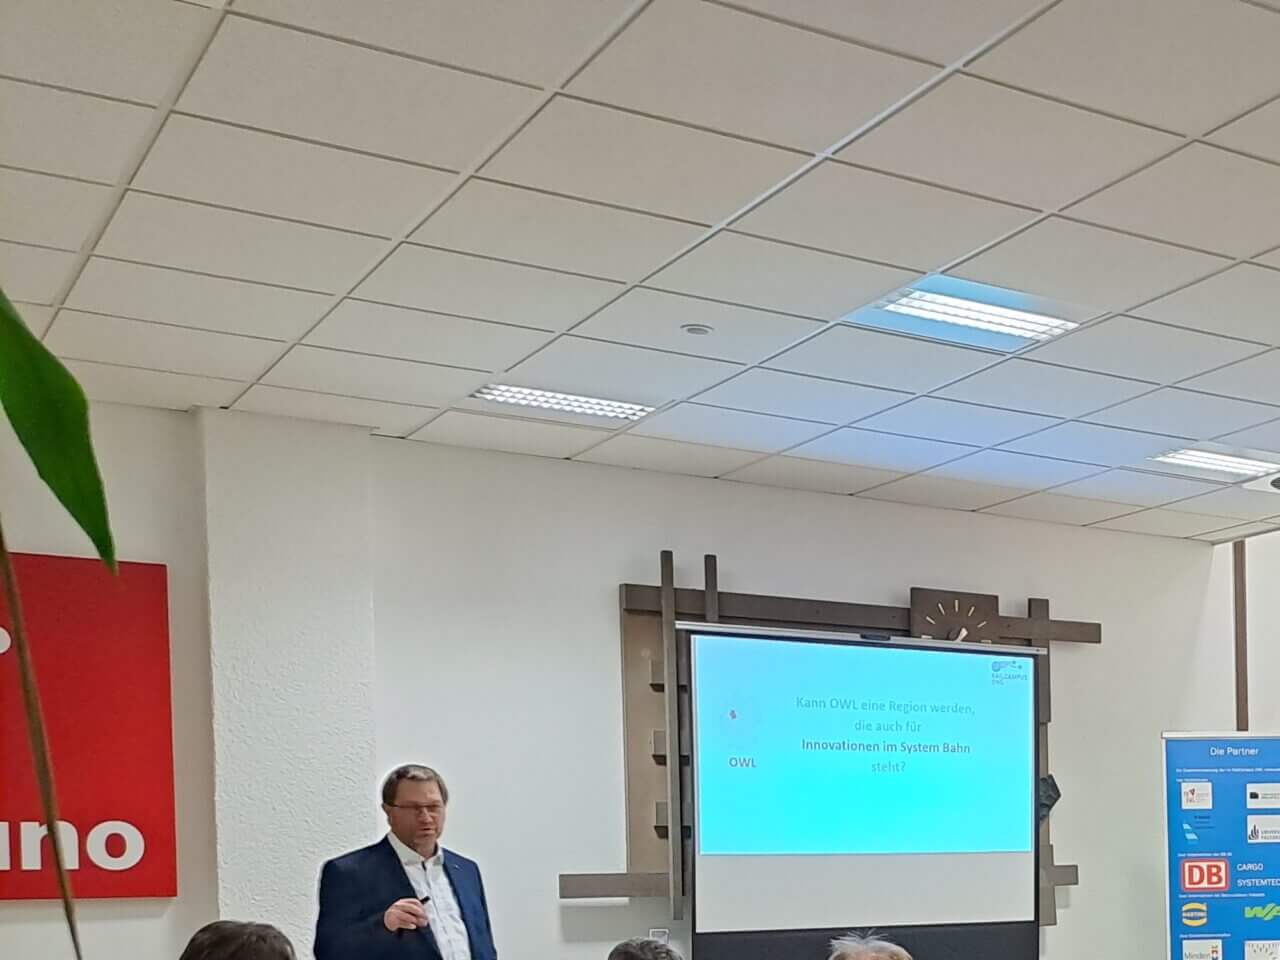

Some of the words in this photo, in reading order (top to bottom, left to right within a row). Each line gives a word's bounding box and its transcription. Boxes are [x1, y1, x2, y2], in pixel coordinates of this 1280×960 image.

[796, 696, 827, 709] Kann
[829, 698, 858, 710] OWL
[860, 700, 886, 712] eine
[889, 700, 927, 714] Region
[929, 703, 975, 716] werden,
[854, 719, 873, 732] die
[875, 720, 903, 733] auch
[905, 720, 921, 733] für
[802, 739, 880, 752] Innovationen
[882, 740, 897, 752] im
[900, 741, 940, 755] System
[943, 742, 971, 753] Bahn
[1210, 747, 1225, 756] Die
[1227, 747, 1259, 756] Partner
[728, 757, 757, 768] OWL
[871, 760, 907, 773] steht?
[1236, 863, 1264, 871] CARGO
[1187, 864, 1223, 886] DB
